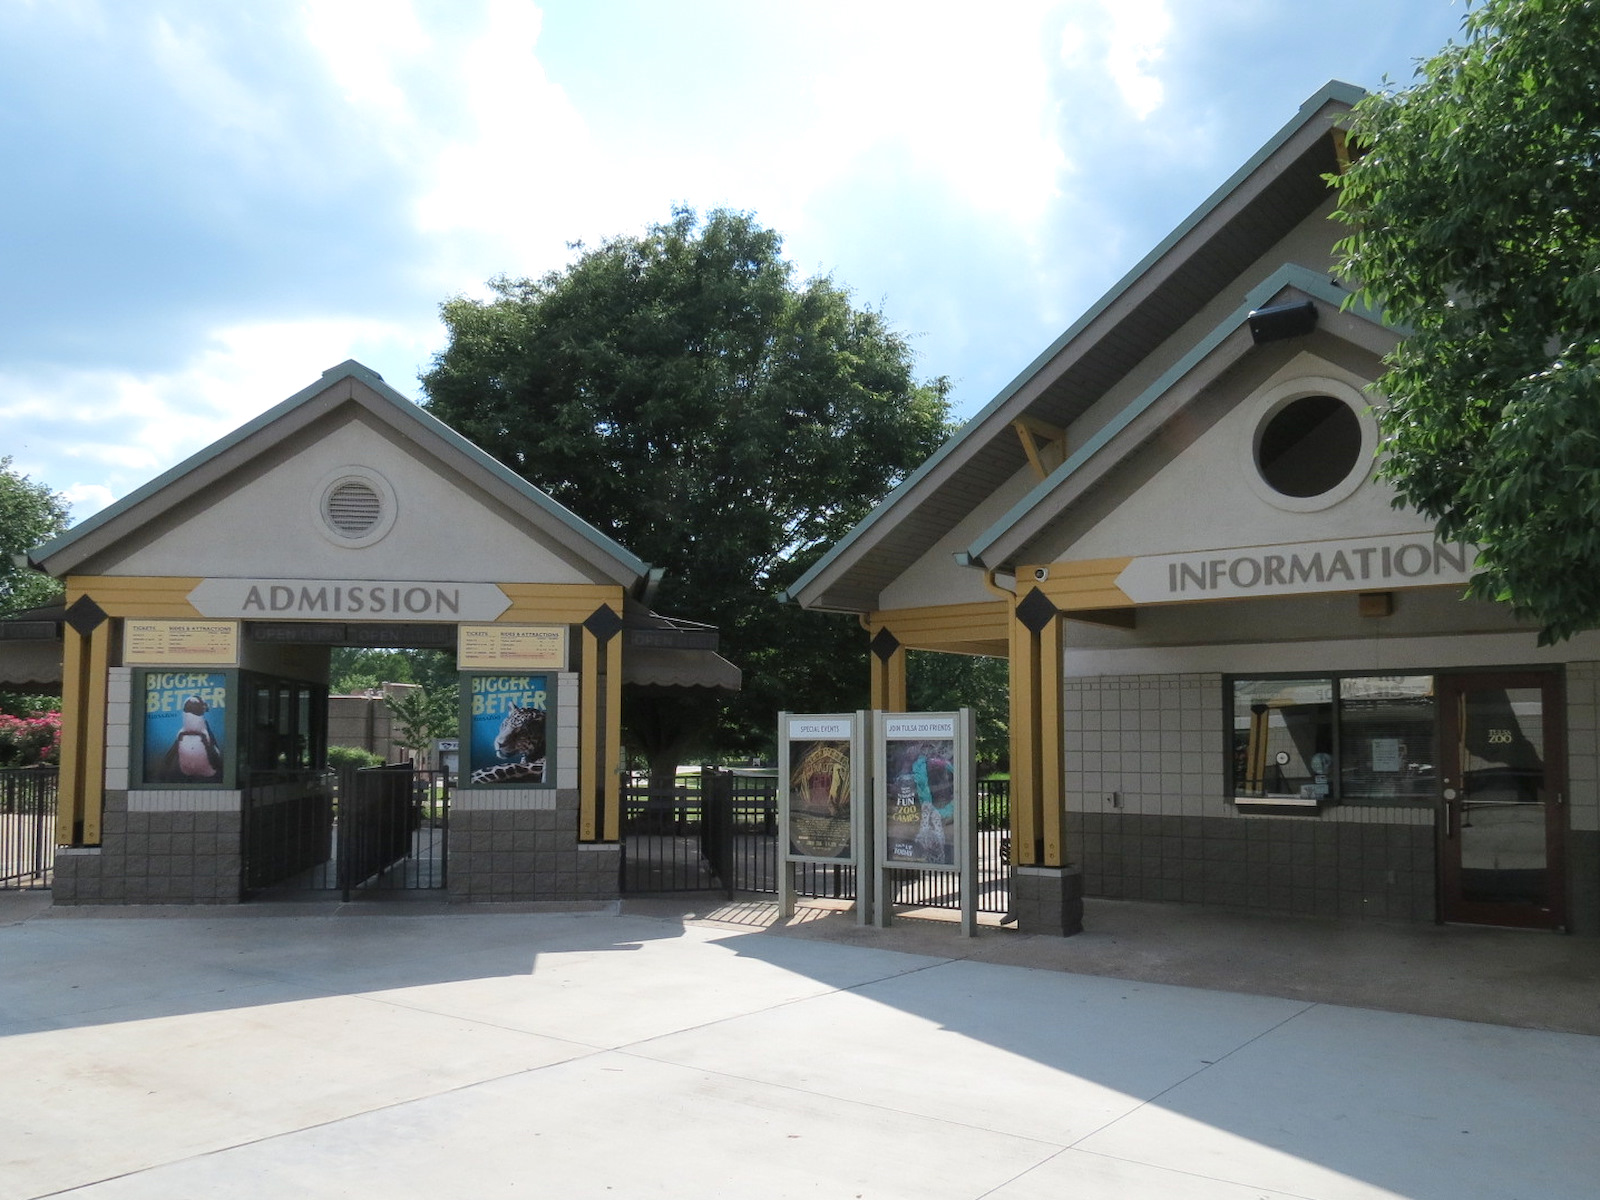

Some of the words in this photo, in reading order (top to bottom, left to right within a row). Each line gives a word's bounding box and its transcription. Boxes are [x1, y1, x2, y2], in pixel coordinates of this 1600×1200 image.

[1168, 542, 1466, 592] INFORMATION
[242, 585, 460, 614] ADMISSION
[146, 673, 214, 691] BIGGER.
[471, 676, 535, 694] BIGGER.
[146, 687, 226, 713] BETTER
[471, 690, 547, 715] BETTER
[800, 725, 820, 733] SPECIAL
[821, 725, 840, 733] EVENTS
[901, 724, 917, 732] TULSA
[929, 723, 951, 731] FRIENDS
[1488, 735, 1512, 744] ZOO
[896, 797, 915, 806] FUN
[898, 805, 917, 814] ZOO
[892, 812, 920, 823] CAMPS
